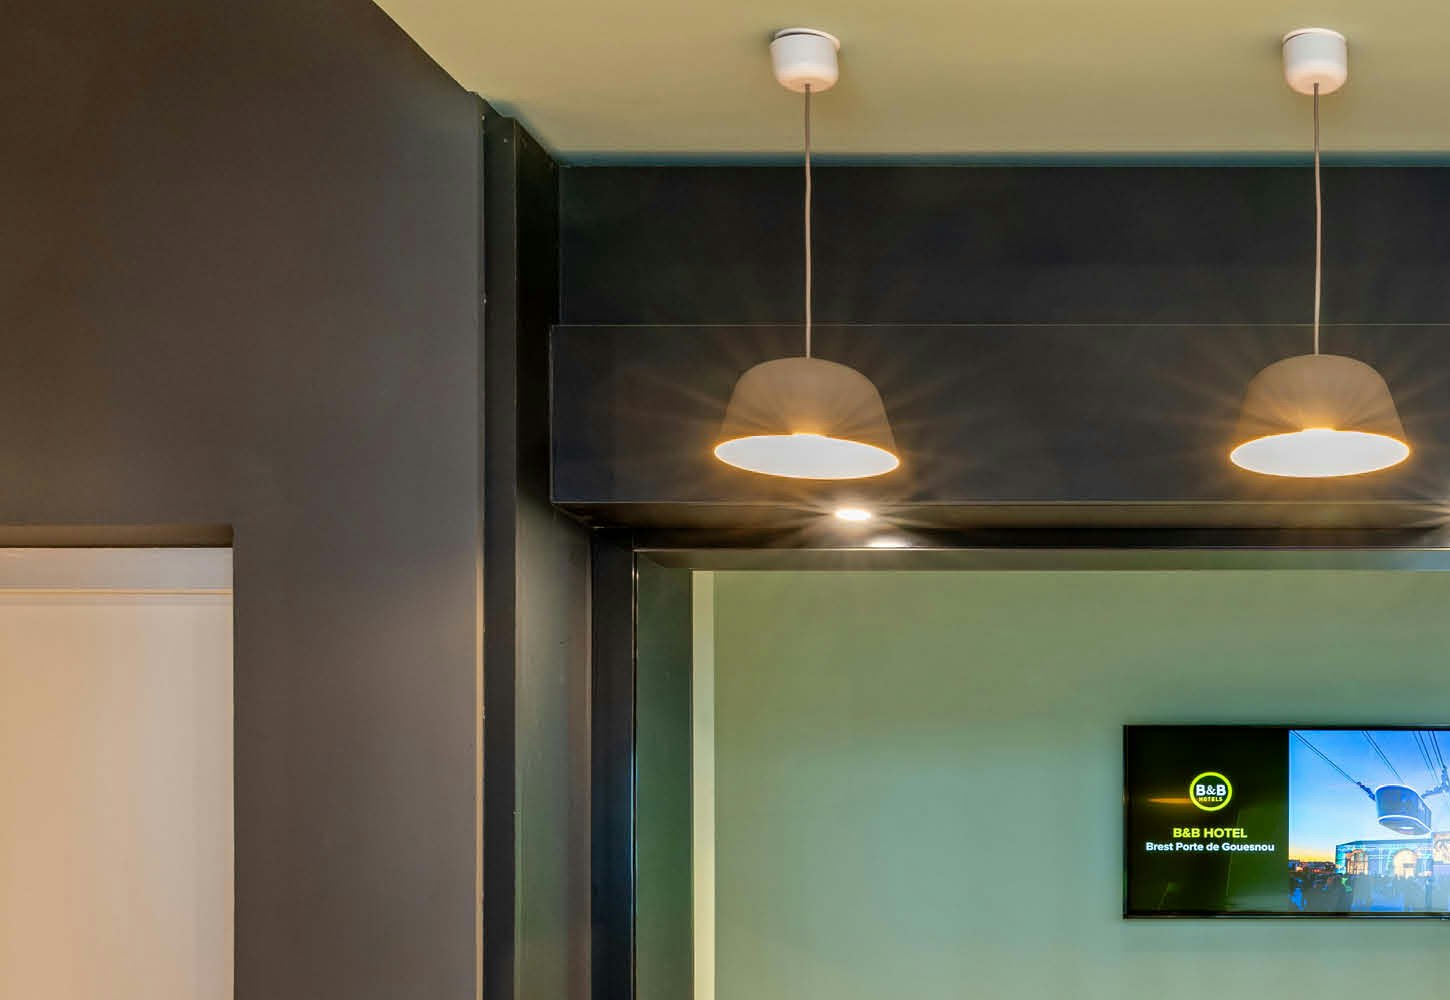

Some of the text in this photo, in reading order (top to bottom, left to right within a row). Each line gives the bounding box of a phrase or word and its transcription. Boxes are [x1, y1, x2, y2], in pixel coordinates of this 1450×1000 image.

[1196, 784, 1227, 797] B&B
[1173, 828, 1248, 838] B&B HOTEL
[1145, 842, 1275, 851] Brest Porte de Gouesnou
